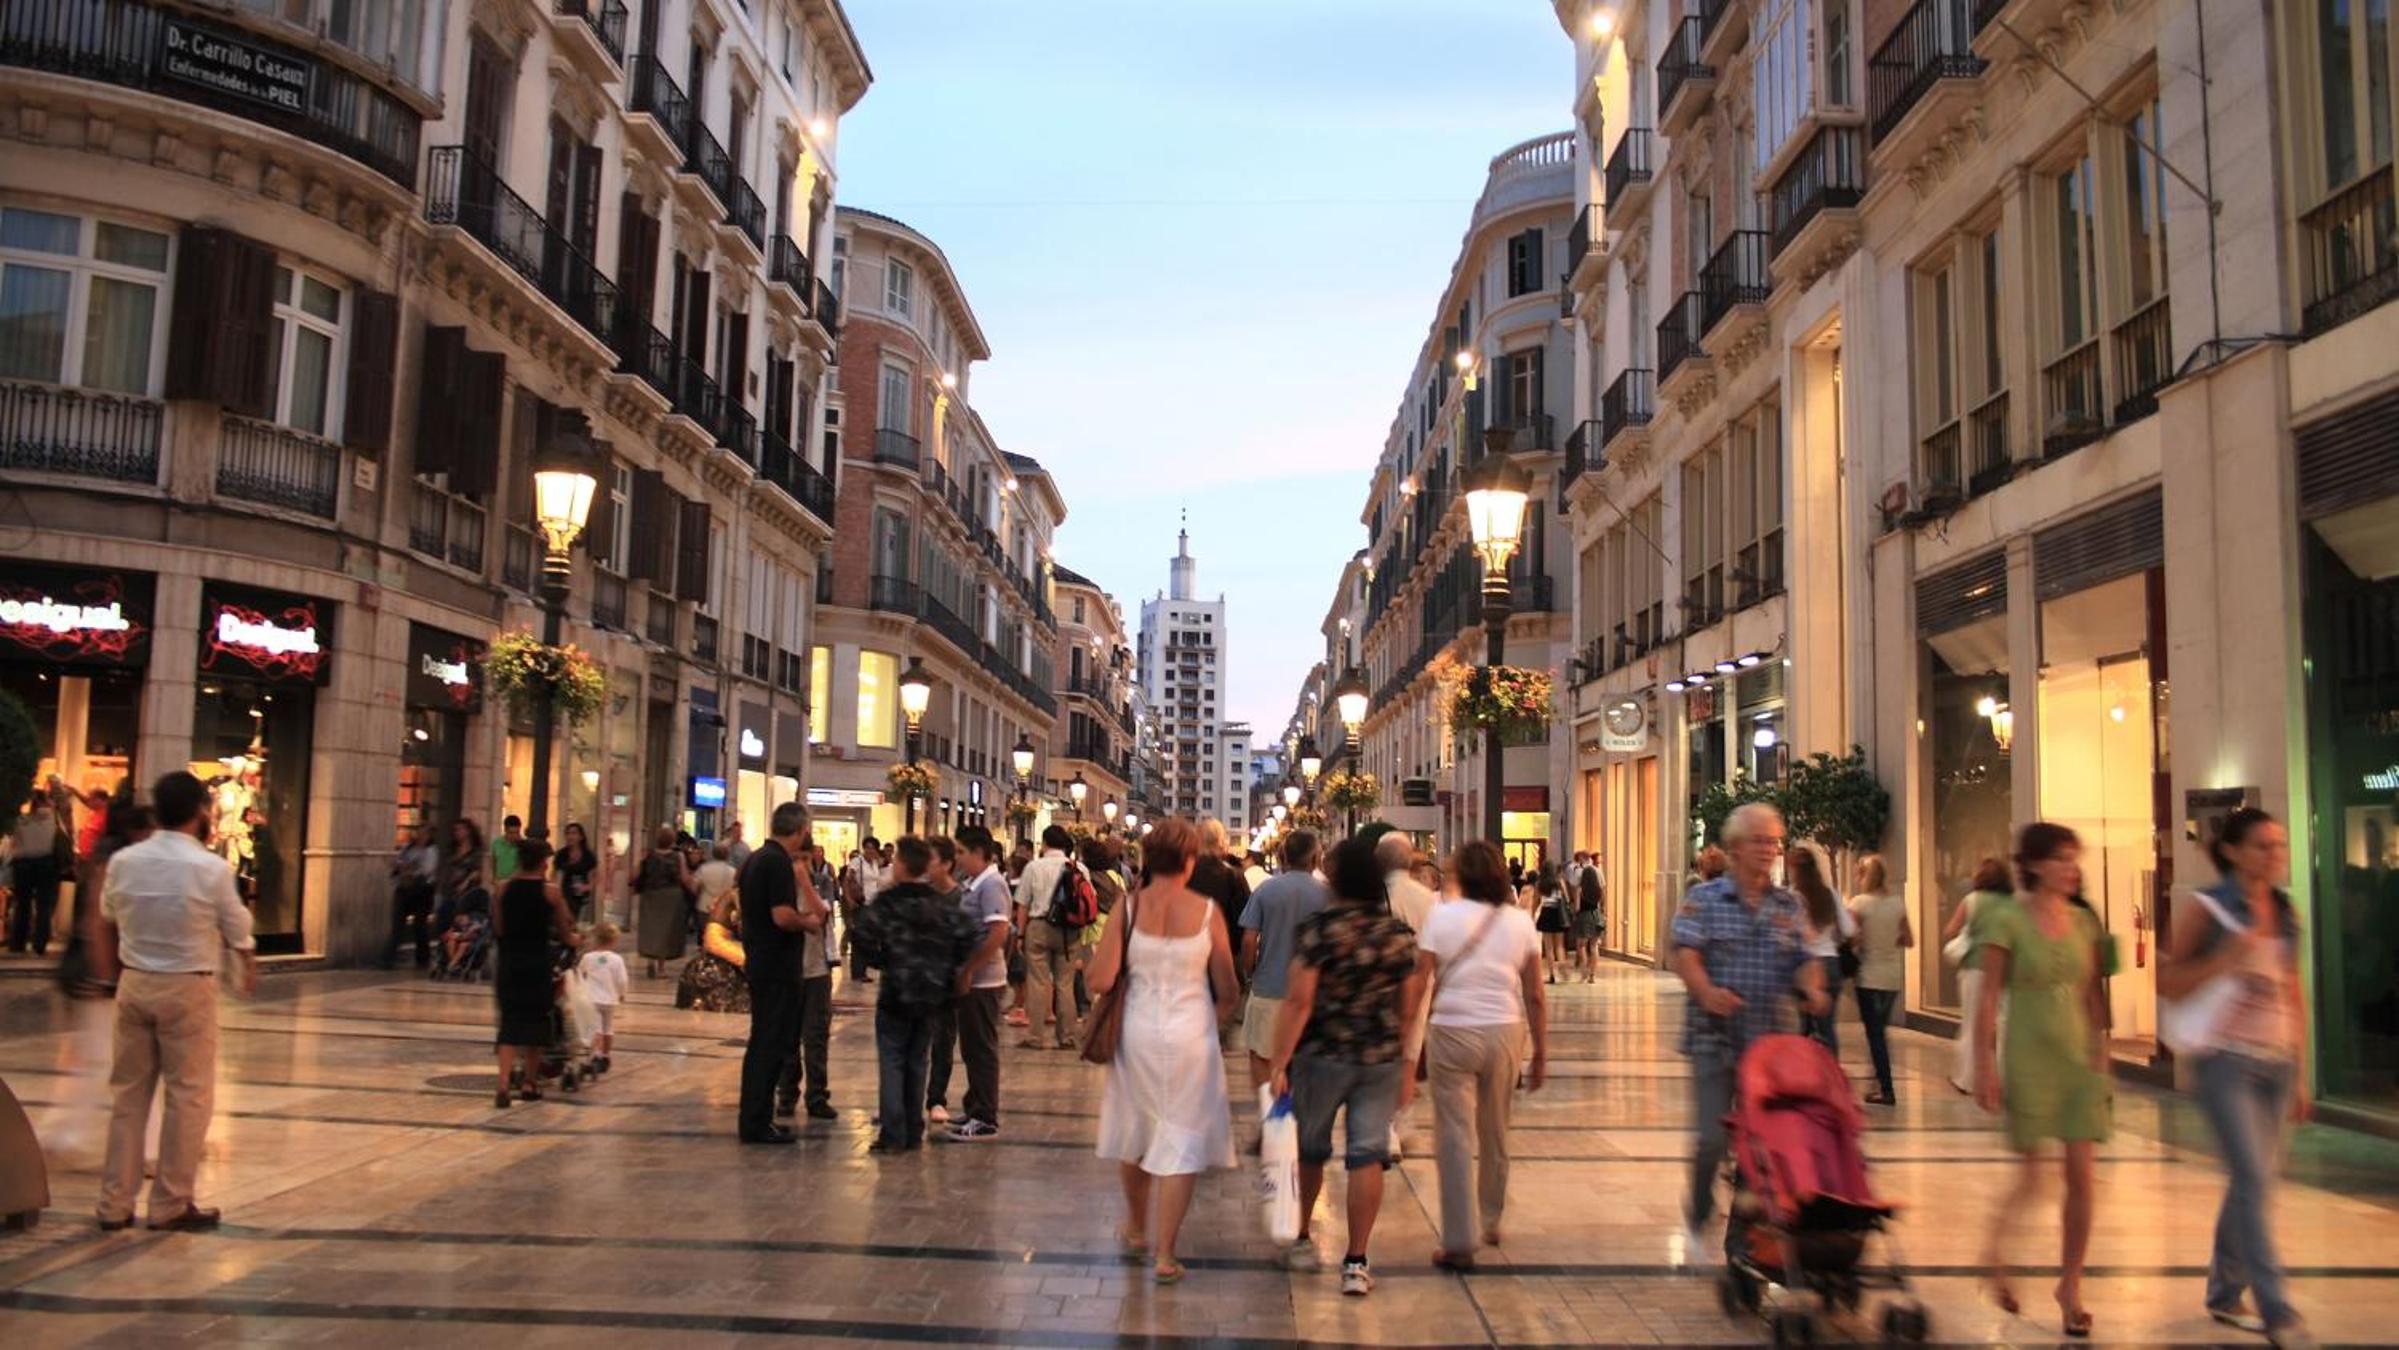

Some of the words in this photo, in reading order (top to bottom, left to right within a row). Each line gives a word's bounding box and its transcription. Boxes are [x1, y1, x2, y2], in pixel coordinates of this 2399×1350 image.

[168, 26, 188, 53] Dr.
[192, 34, 252, 70] Carrillo
[268, 85, 301, 109] PIEL
